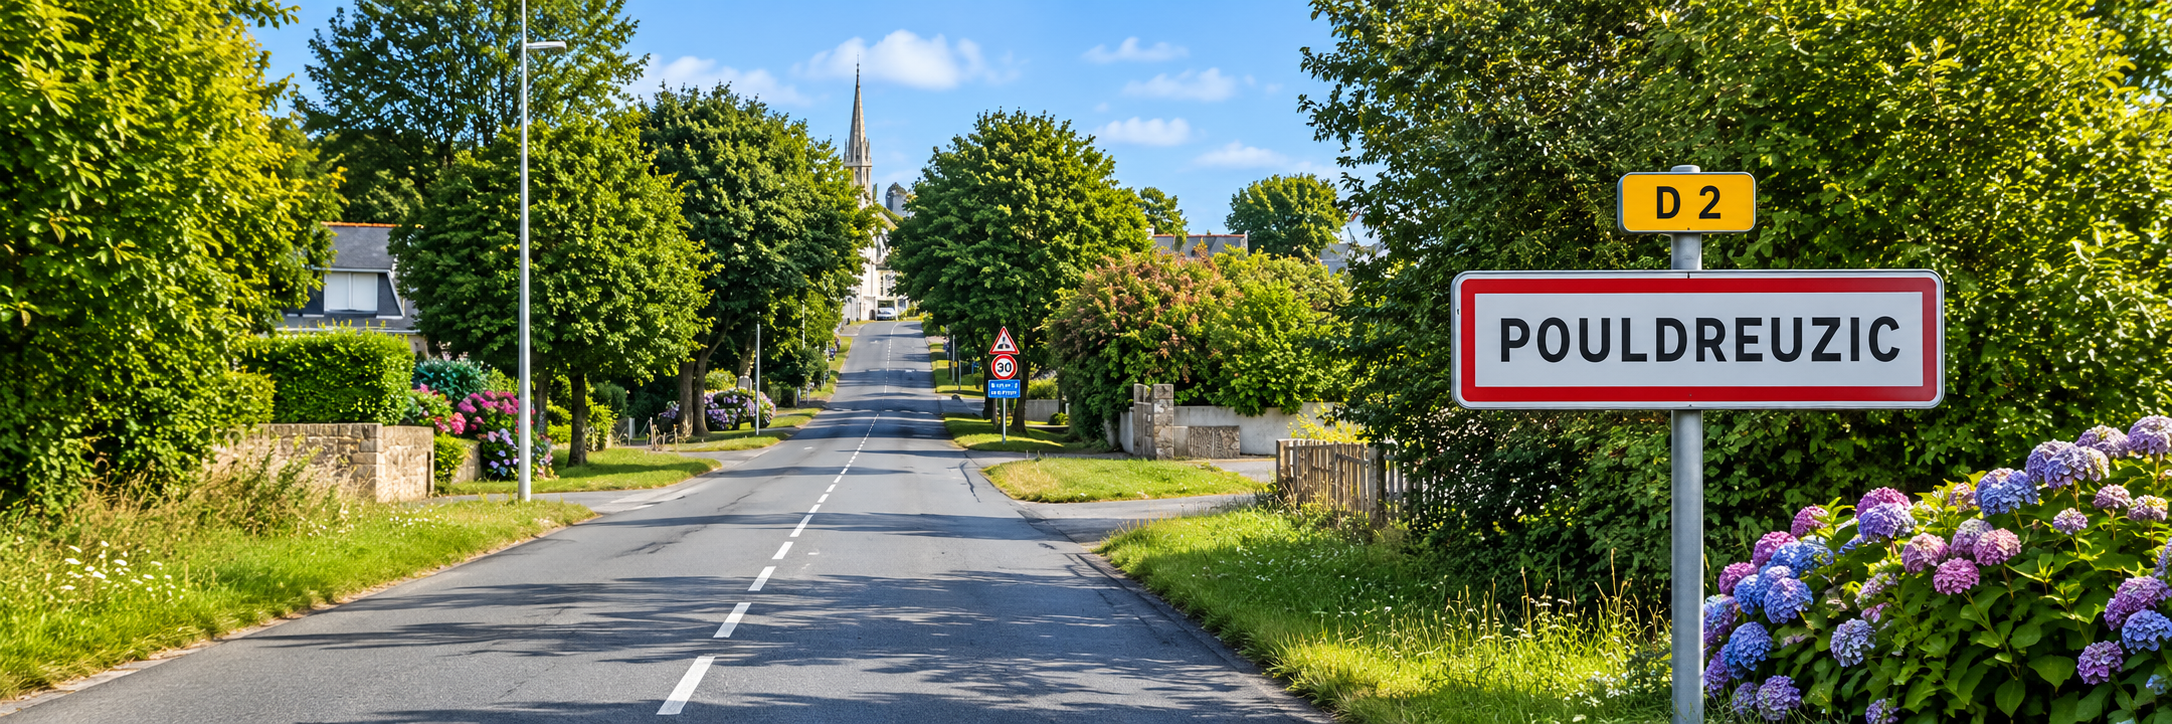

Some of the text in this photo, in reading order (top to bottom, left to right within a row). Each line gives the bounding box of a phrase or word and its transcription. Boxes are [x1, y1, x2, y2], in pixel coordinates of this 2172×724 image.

[1656, 186, 1721, 219] D 2
[1500, 316, 1901, 363] POULDREUZIC
[997, 362, 1012, 373] 30
